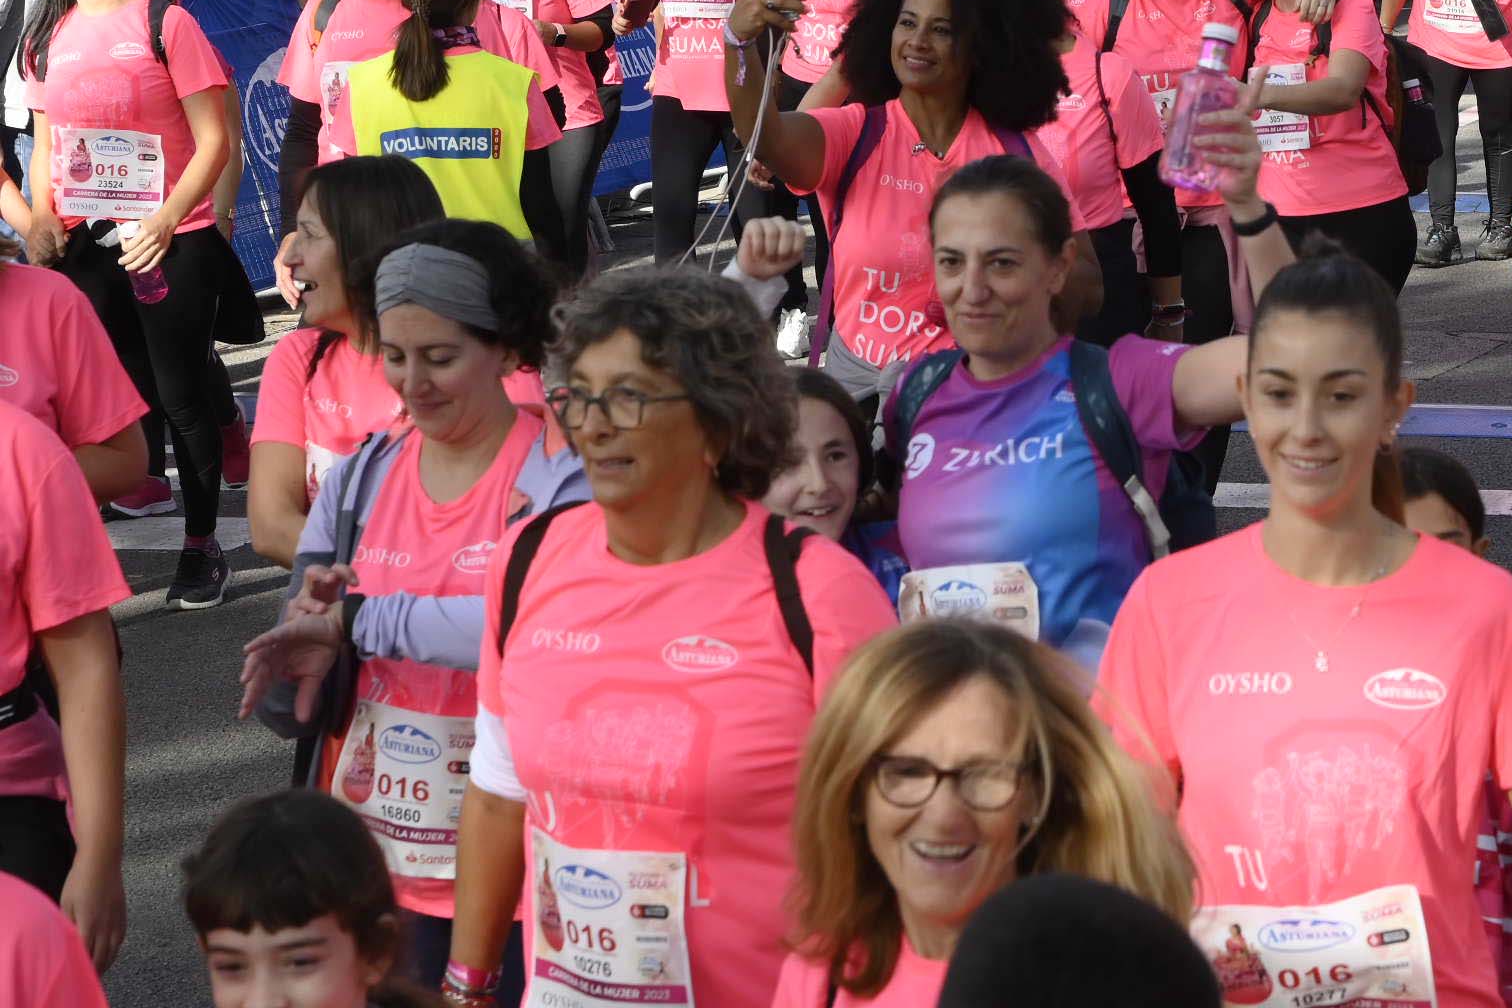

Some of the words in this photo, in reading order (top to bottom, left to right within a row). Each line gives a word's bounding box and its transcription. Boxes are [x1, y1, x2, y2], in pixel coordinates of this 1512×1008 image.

[668, 37, 722, 54] SUMA
[1141, 73, 1169, 92] TU
[93, 141, 132, 153] ASTURIANA
[383, 134, 489, 155] VOLUNTARIS
[95, 163, 129, 177] 016
[97, 179, 124, 189] 23524
[100, 190, 108, 198] DE
[108, 191, 117, 199] LA
[69, 201, 99, 212] OYSHO
[862, 266, 901, 293] TU
[852, 332, 912, 368] SUM
[531, 627, 600, 654] OYSHO
[668, 646, 737, 668] ASTURIANA
[1209, 671, 1293, 696] OYSHO
[1370, 680, 1441, 701] ASTURIANA
[383, 736, 436, 758] ASTURIANA
[377, 773, 430, 802] 016
[381, 804, 421, 824] 16860
[394, 827, 409, 838] LA
[409, 830, 446, 842] MUJER
[1224, 844, 1269, 891] TU
[559, 876, 617, 901] ASTURIANA
[566, 919, 618, 952] 016
[1266, 928, 1349, 943] ASTURIANA
[1277, 963, 1354, 990] 016
[603, 985, 640, 1000] MUJER
[1291, 988, 1348, 1007] 10277
